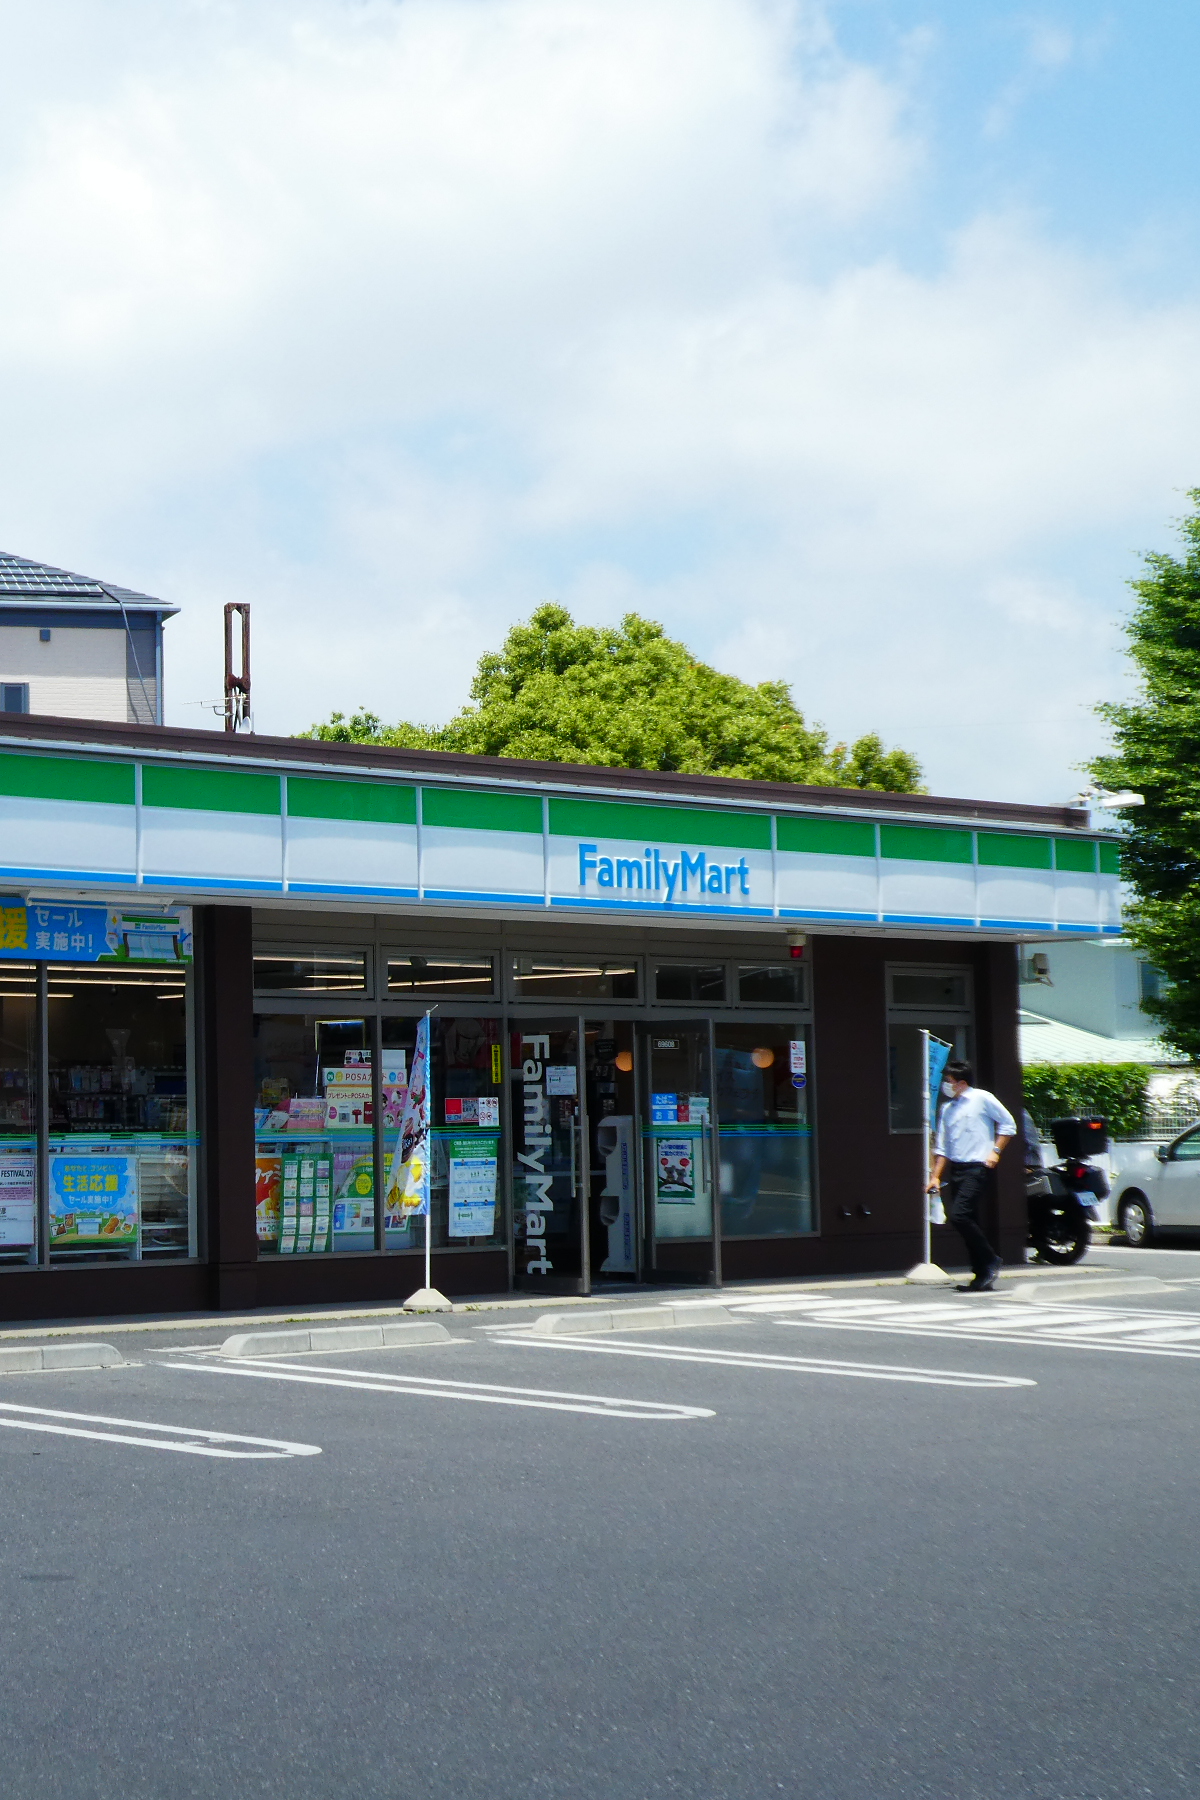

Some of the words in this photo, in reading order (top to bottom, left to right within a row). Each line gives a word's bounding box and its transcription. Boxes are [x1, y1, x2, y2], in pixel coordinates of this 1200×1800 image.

[578, 843, 750, 902] FamilyMart
[34, 906, 83, 928] セール
[35, 930, 93, 953] 実施中!
[516, 1034, 554, 1275] FamilyMart
[0, 1169, 25, 1178] FESTIVAL
[62, 1174, 119, 1192] 生活応援
